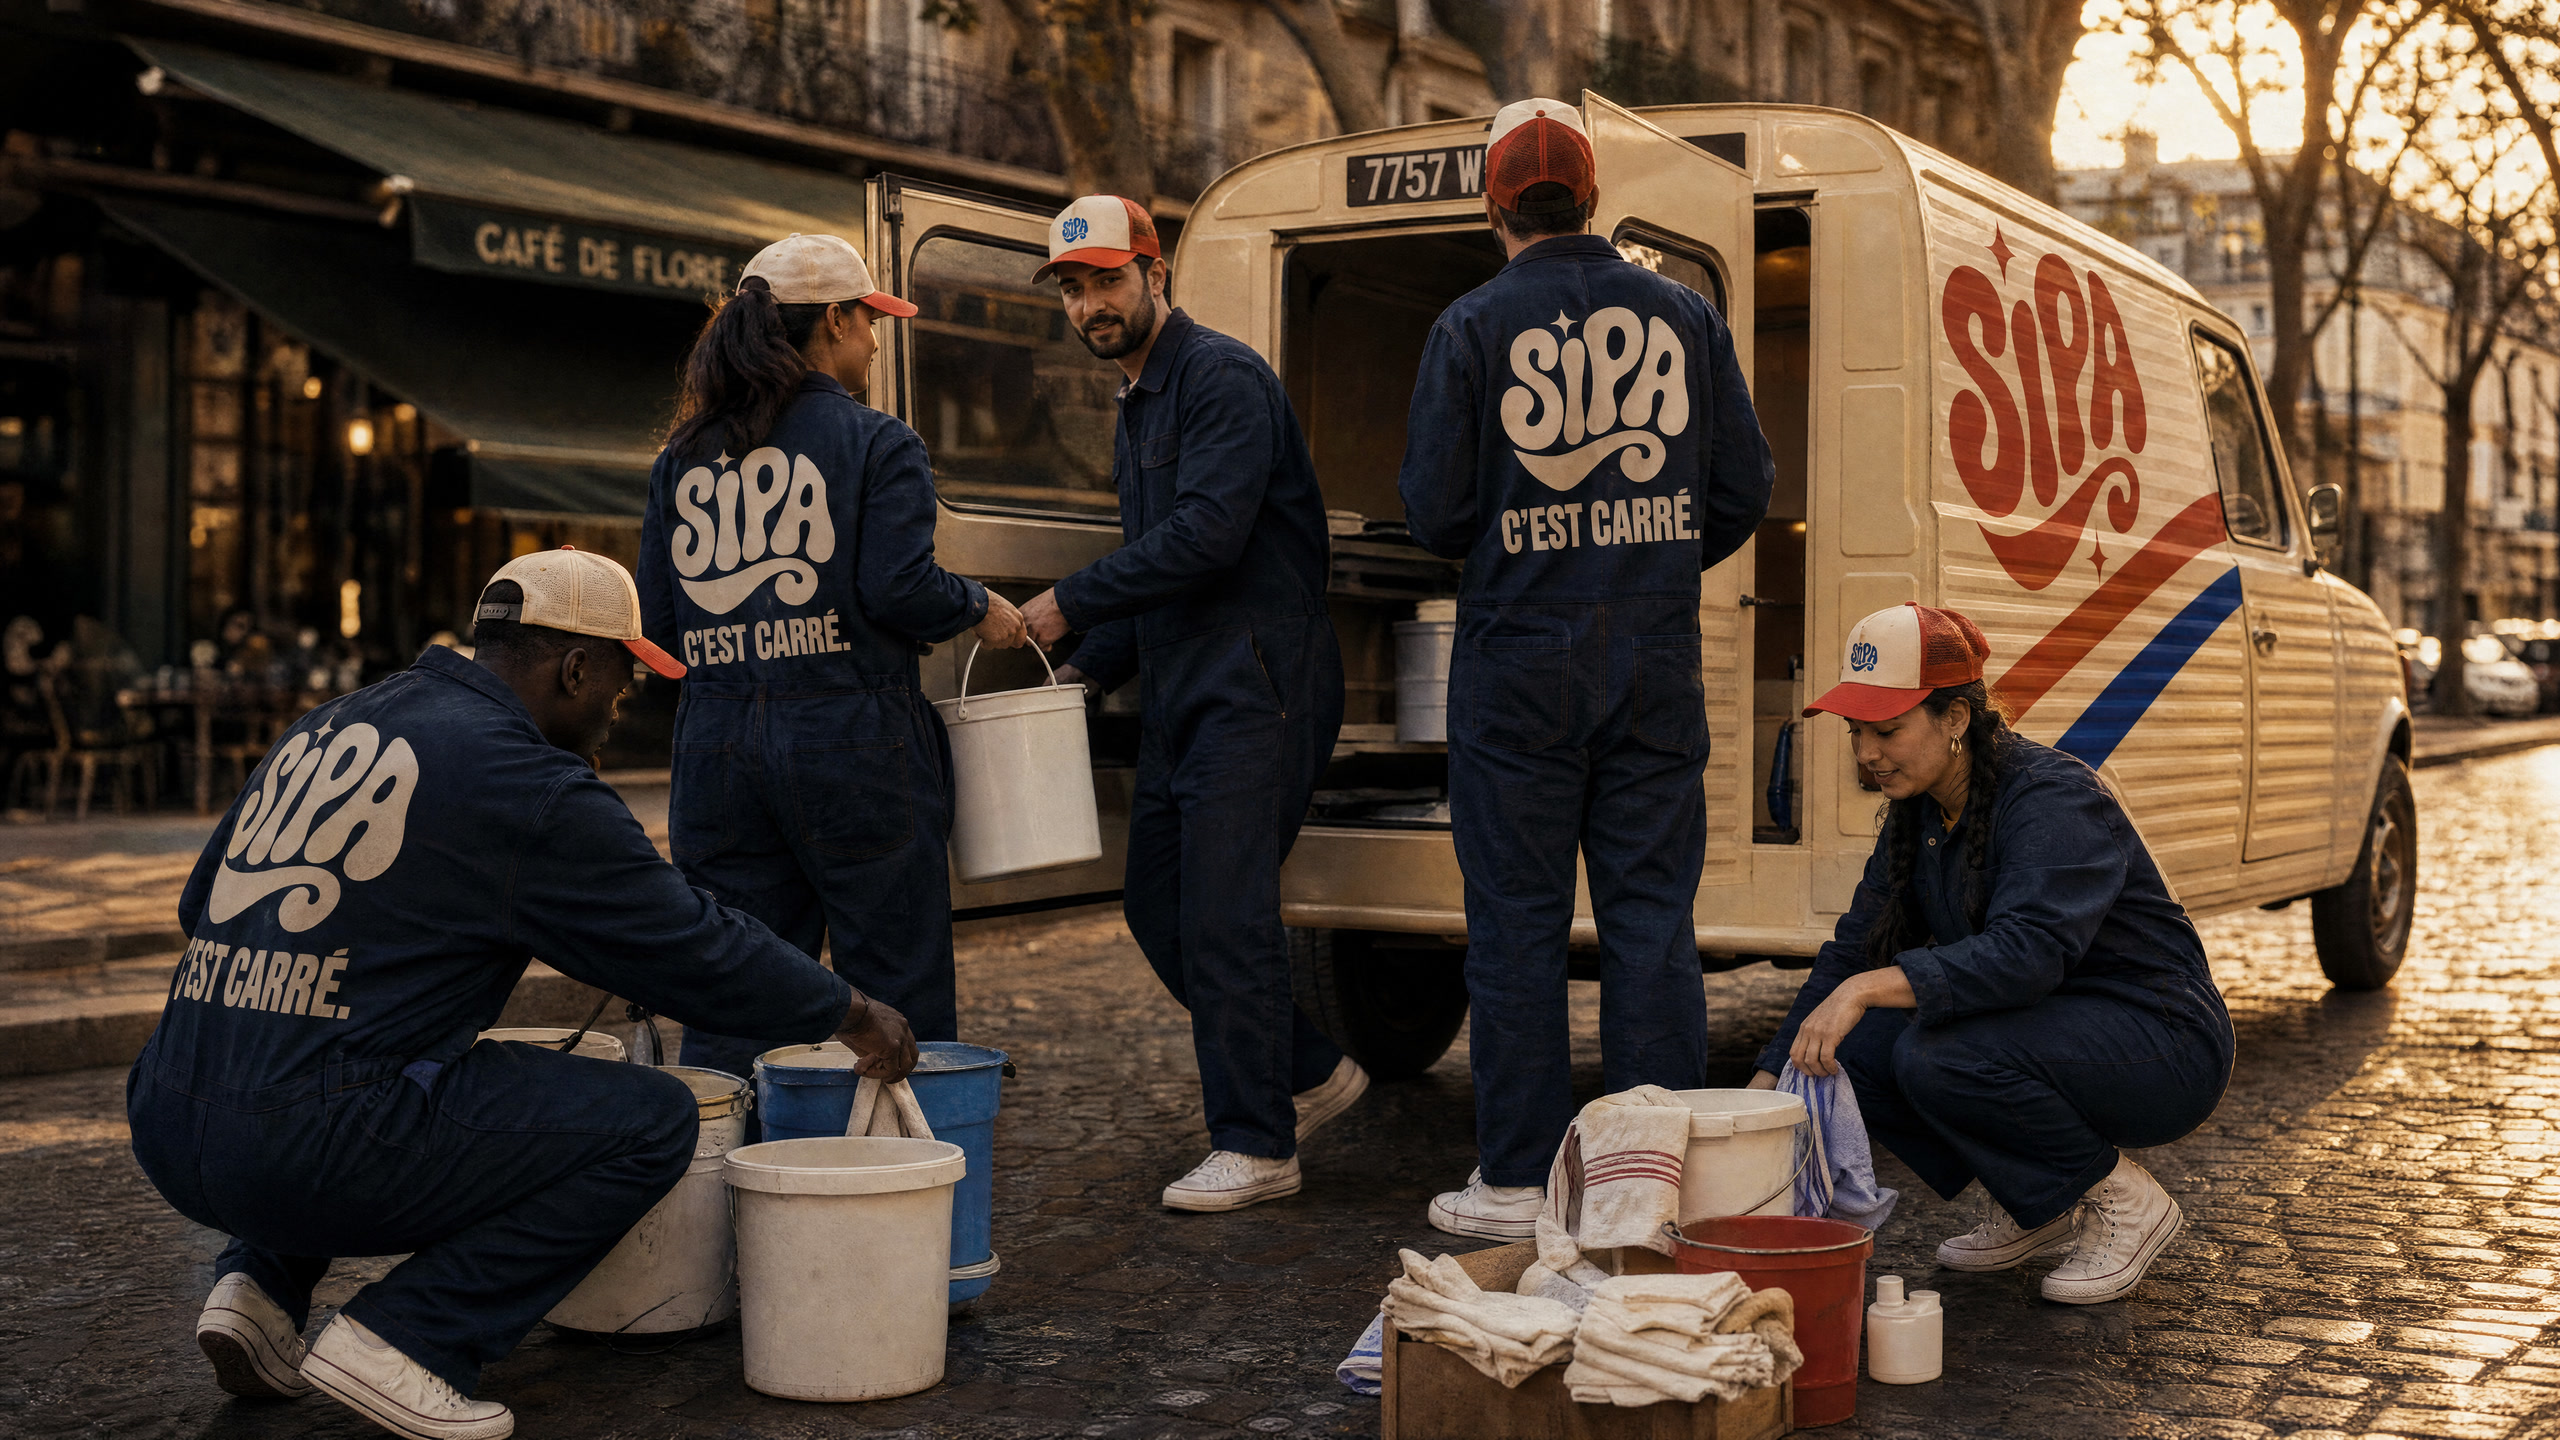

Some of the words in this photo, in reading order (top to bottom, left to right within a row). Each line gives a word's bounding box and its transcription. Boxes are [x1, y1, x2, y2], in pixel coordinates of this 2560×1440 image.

[1365, 152, 1447, 201] 7757
[475, 221, 567, 273] CAFÉ
[577, 236, 621, 281] DE
[632, 244, 730, 292] FLORE
[1501, 502, 1583, 554] C'EST
[1590, 487, 1701, 546] CARRÉ.
[683, 623, 747, 668] C'EST
[754, 607, 851, 661] CARRÉ.
[223, 948, 351, 1020] CARRÉ.
